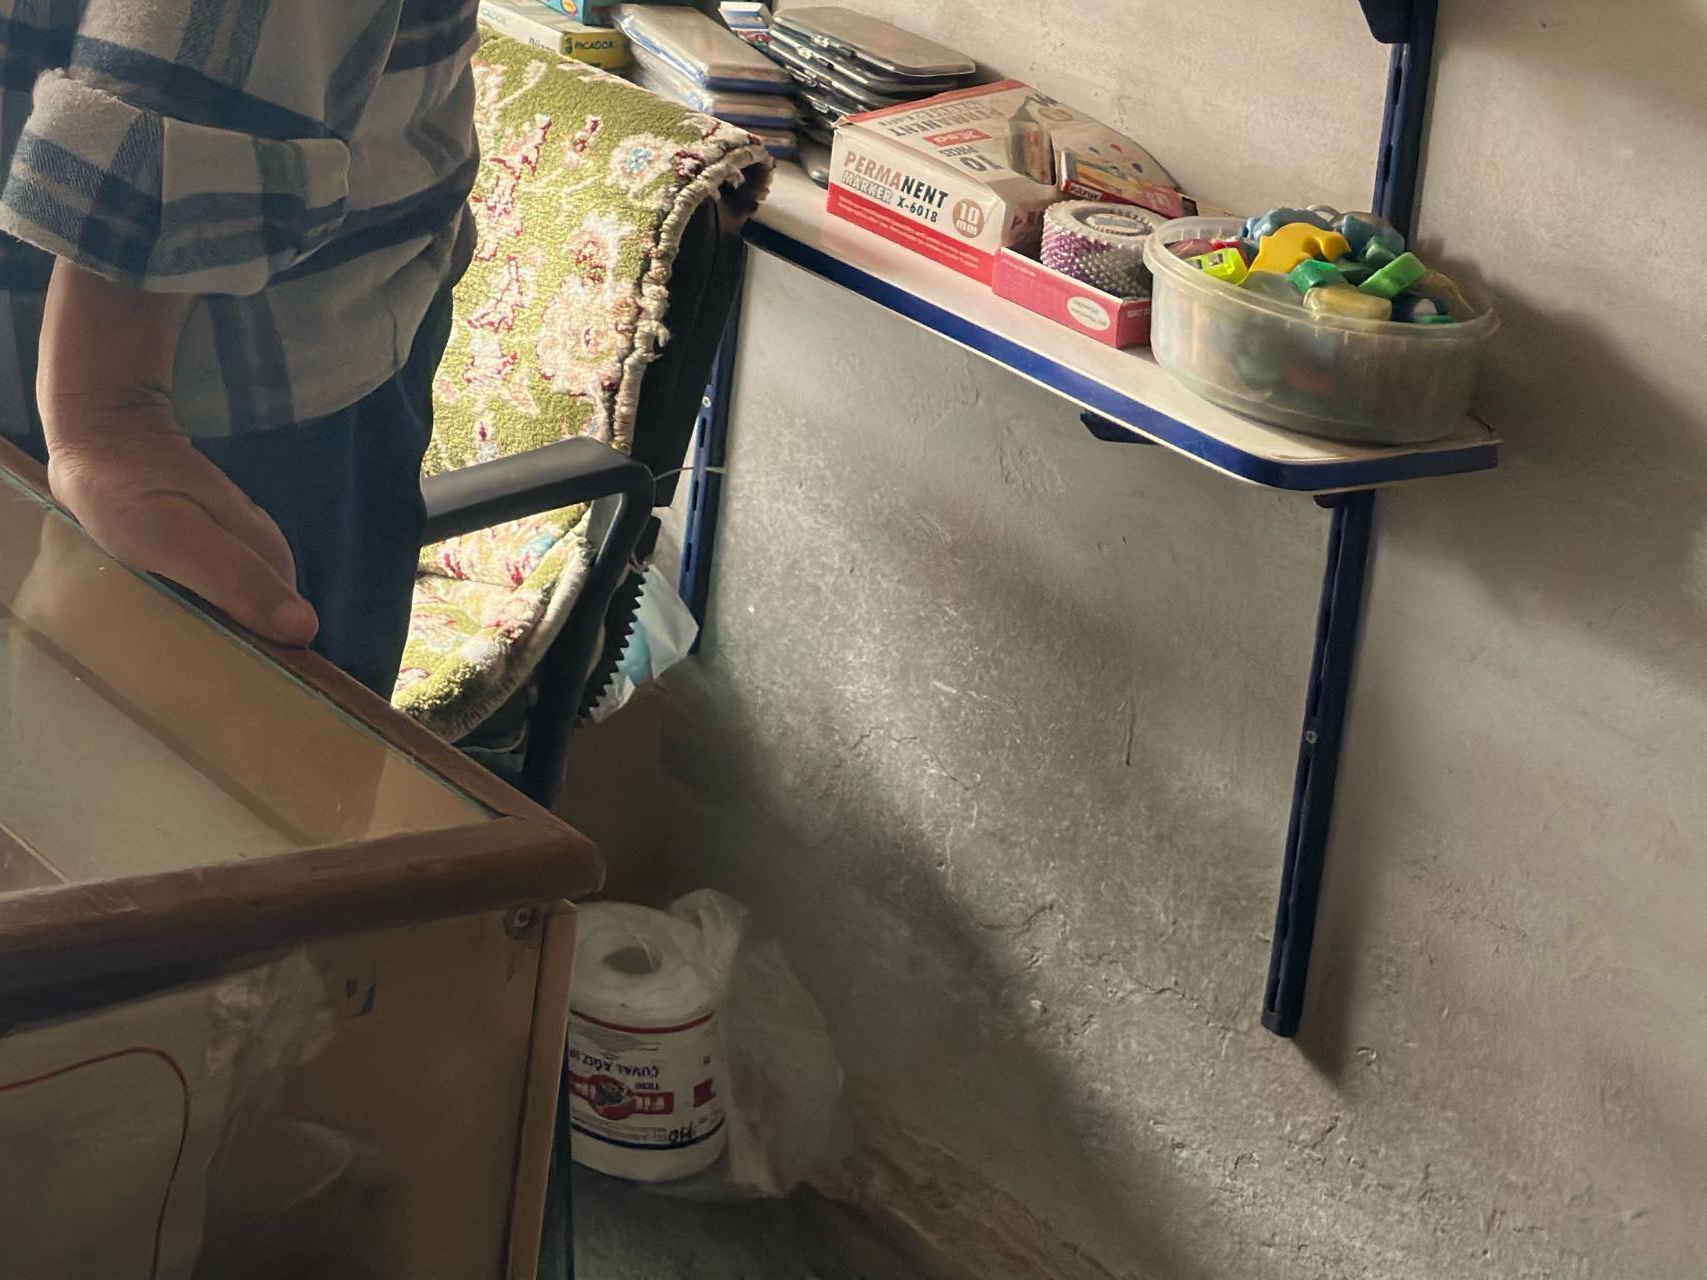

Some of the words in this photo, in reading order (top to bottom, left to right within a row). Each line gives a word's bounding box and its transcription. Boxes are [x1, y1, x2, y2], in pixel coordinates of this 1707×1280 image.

[842, 170, 893, 204] MARKER
[896, 194, 939, 223] X-6018
[843, 150, 949, 209] PERMANENT
[959, 201, 980, 220] 10
